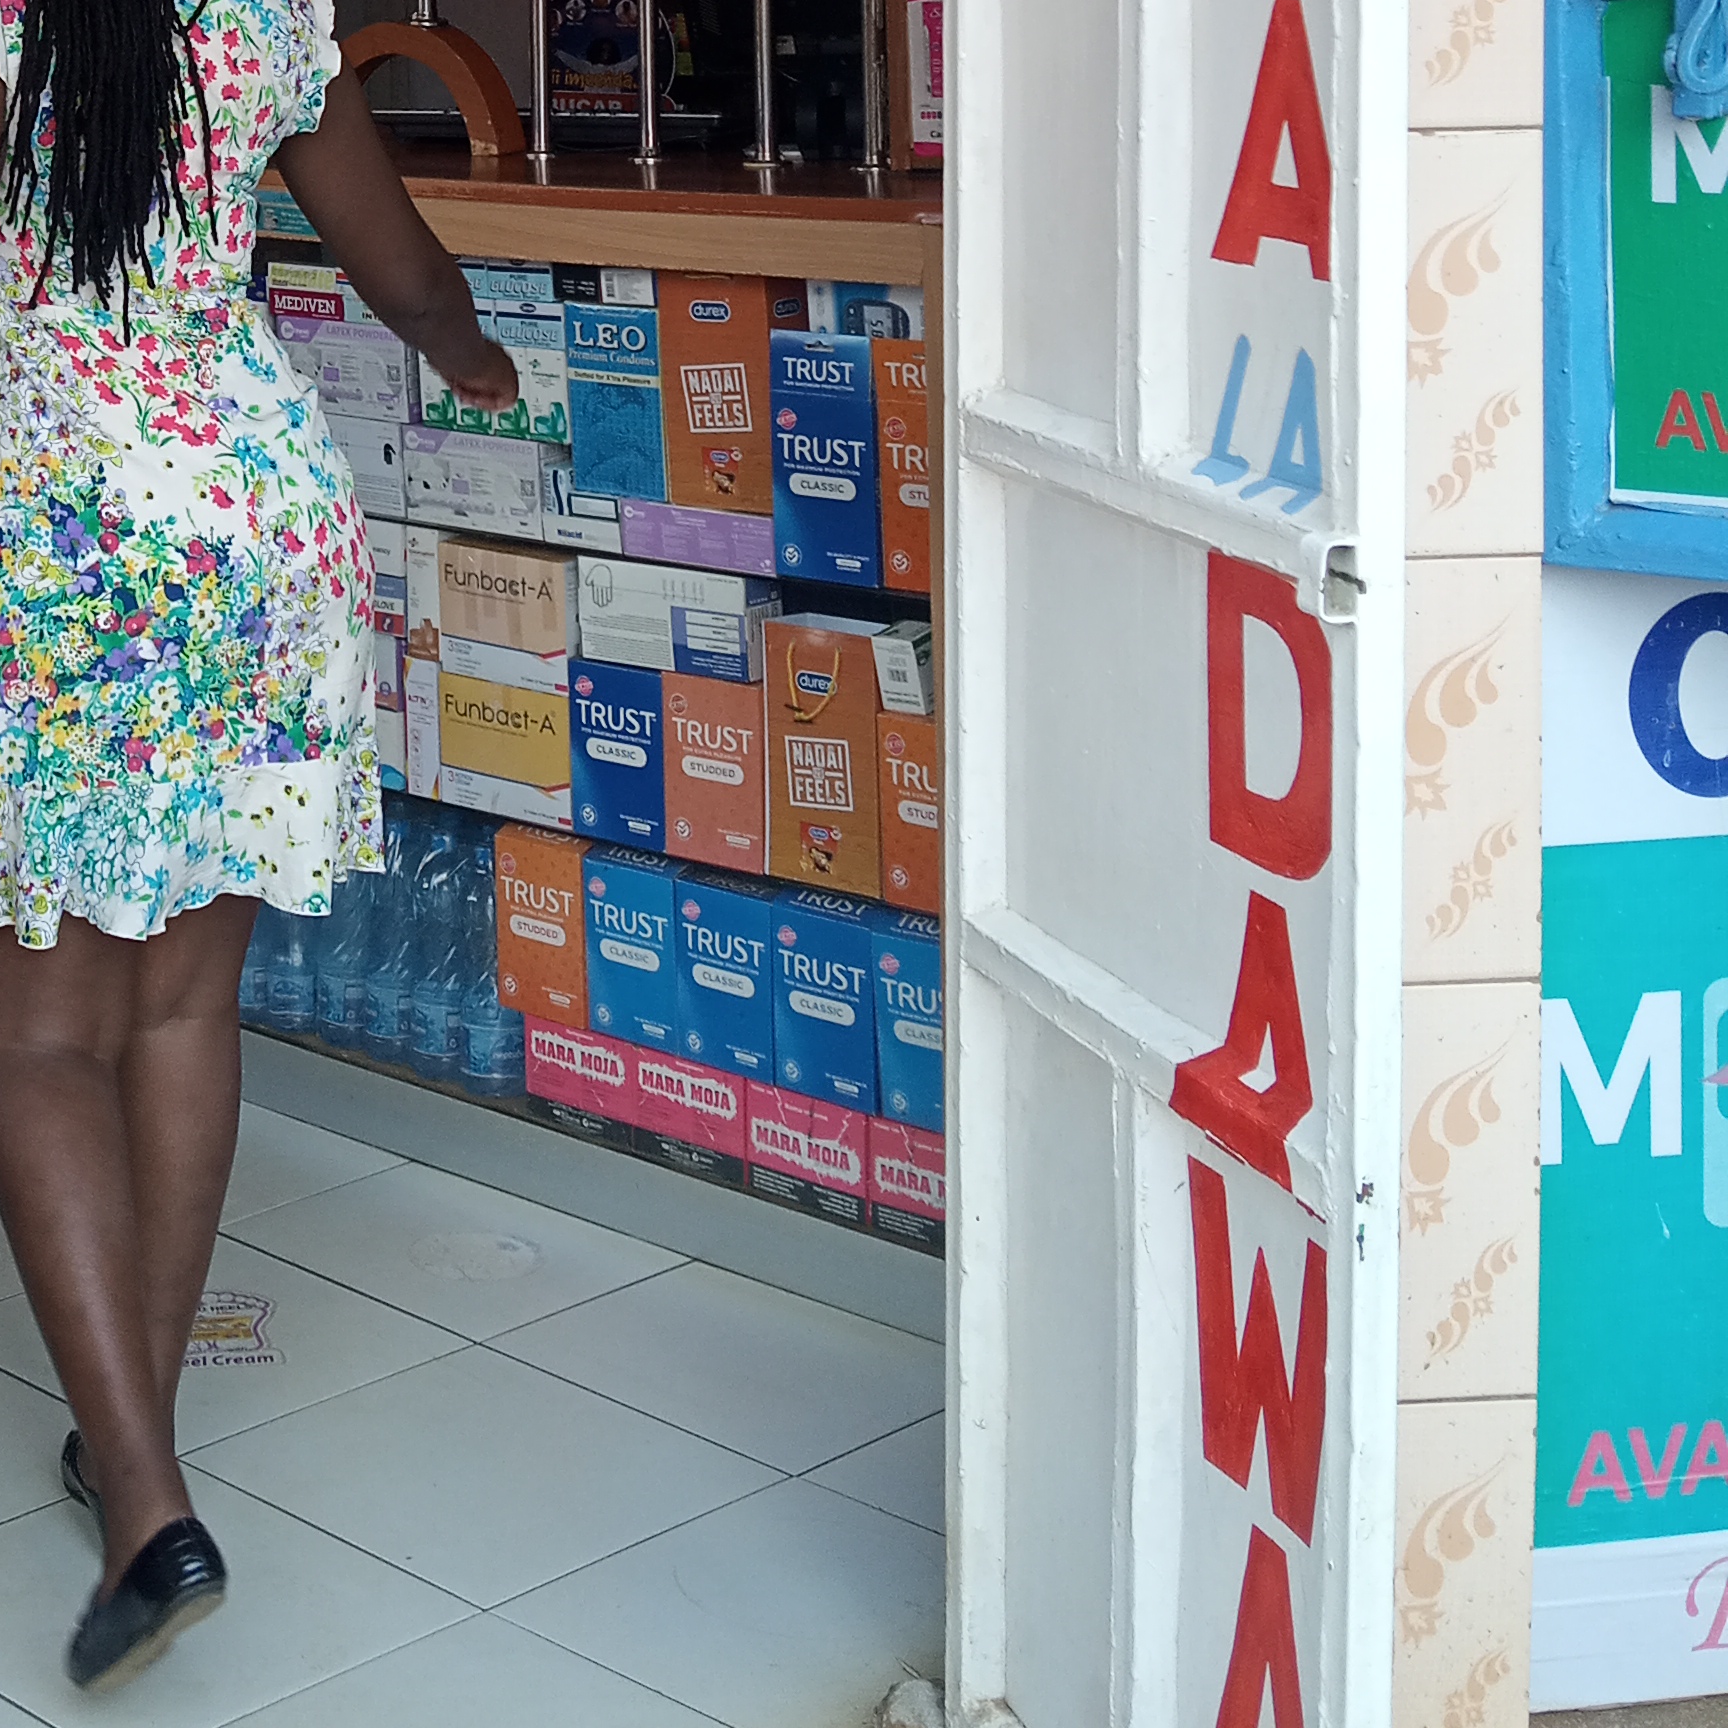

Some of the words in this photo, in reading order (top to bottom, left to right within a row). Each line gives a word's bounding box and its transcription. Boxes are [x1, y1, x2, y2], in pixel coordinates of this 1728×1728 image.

[489, 278, 547, 295] GLUCOSE
[273, 294, 337, 315] MEDIVEN
[693, 305, 726, 318] durex
[500, 325, 559, 343] GLUCOSE
[573, 321, 647, 352] LEO
[568, 347, 608, 363] Premium
[609, 352, 656, 367] Condoms
[783, 356, 855, 385] TRUST
[688, 369, 742, 393] NADAI
[693, 403, 745, 428] FEELS
[1192, 332, 1323, 515] LA
[777, 432, 866, 469] TRUST
[885, 442, 929, 473] TR
[800, 479, 845, 494] CLASSIC
[444, 563, 553, 601] Funbact-A
[445, 694, 556, 735] Funbact-A
[576, 698, 657, 737] TRUST
[672, 717, 754, 755] TRUST
[596, 744, 637, 760] CLASSIC
[792, 741, 843, 769] NADAI
[690, 762, 735, 778] STUDDED
[795, 779, 846, 805] FEELS
[500, 875, 574, 917] TRUST
[797, 890, 875, 917] TRUST
[517, 921, 558, 940] STUDDED
[590, 899, 668, 942] TRUST
[610, 946, 650, 964] CLASSIC
[682, 922, 765, 969] TRUST
[702, 971, 745, 991] CLASSIC
[778, 949, 867, 995] TRUST
[799, 998, 844, 1018] CLASSIC
[880, 977, 941, 1015] TRU
[534, 1037, 576, 1065] MARA
[580, 1051, 620, 1078] MOJA
[641, 1069, 685, 1098] MARA
[690, 1083, 731, 1111] MOJA
[756, 1125, 802, 1156] MARA
[807, 1141, 851, 1171] MOJA
[880, 1163, 932, 1194] MARA
[212, 1354, 274, 1366] Cream
